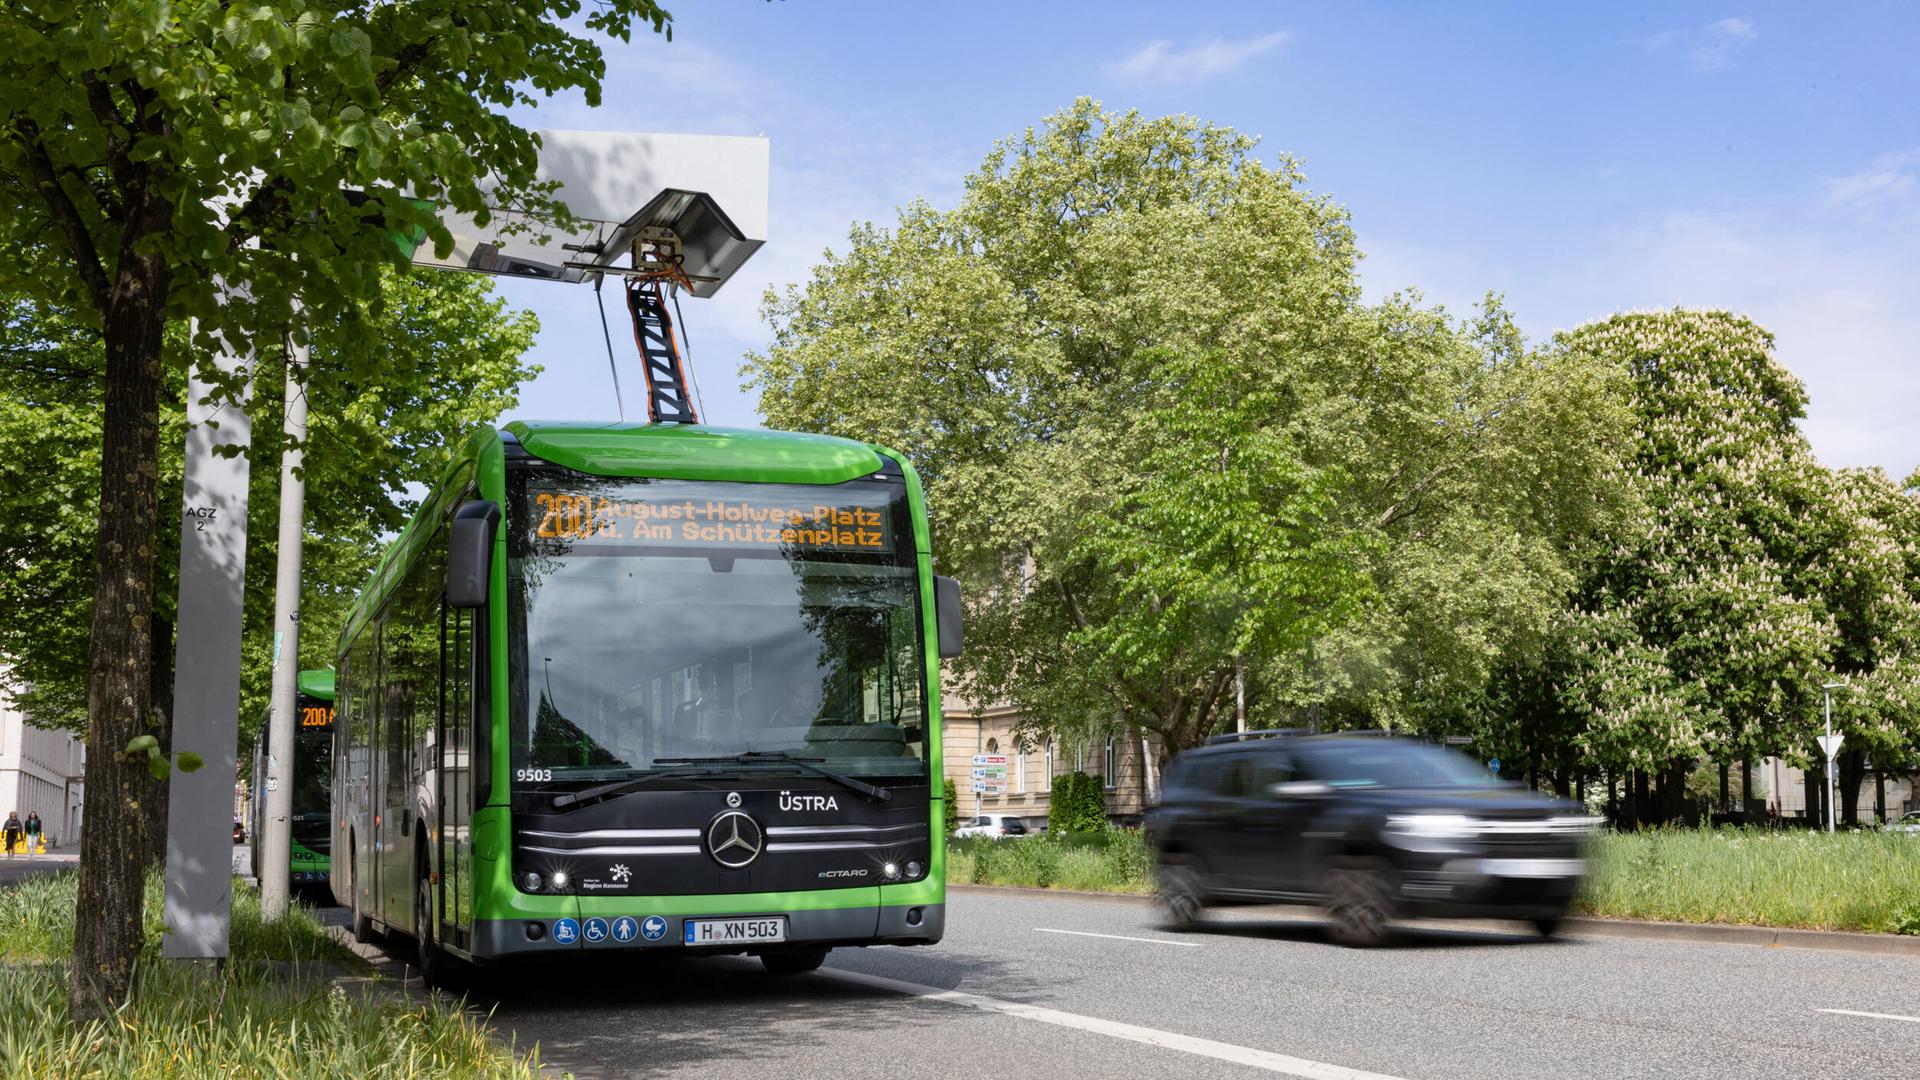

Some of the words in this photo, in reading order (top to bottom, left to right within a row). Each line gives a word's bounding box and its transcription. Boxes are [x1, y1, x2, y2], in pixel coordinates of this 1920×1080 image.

[186, 507, 217, 518] AGZ
[536, 493, 593, 538] 200
[197, 521, 205, 531] 2
[633, 519, 672, 539] Am
[682, 521, 882, 545] Schützenplatz
[303, 707, 326, 726] 200
[517, 769, 552, 781] 9503
[779, 790, 839, 811] ÜSTRA
[583, 882, 602, 890] Region
[702, 924, 713, 940] H
[724, 922, 745, 939] XN
[748, 921, 778, 938] 503
